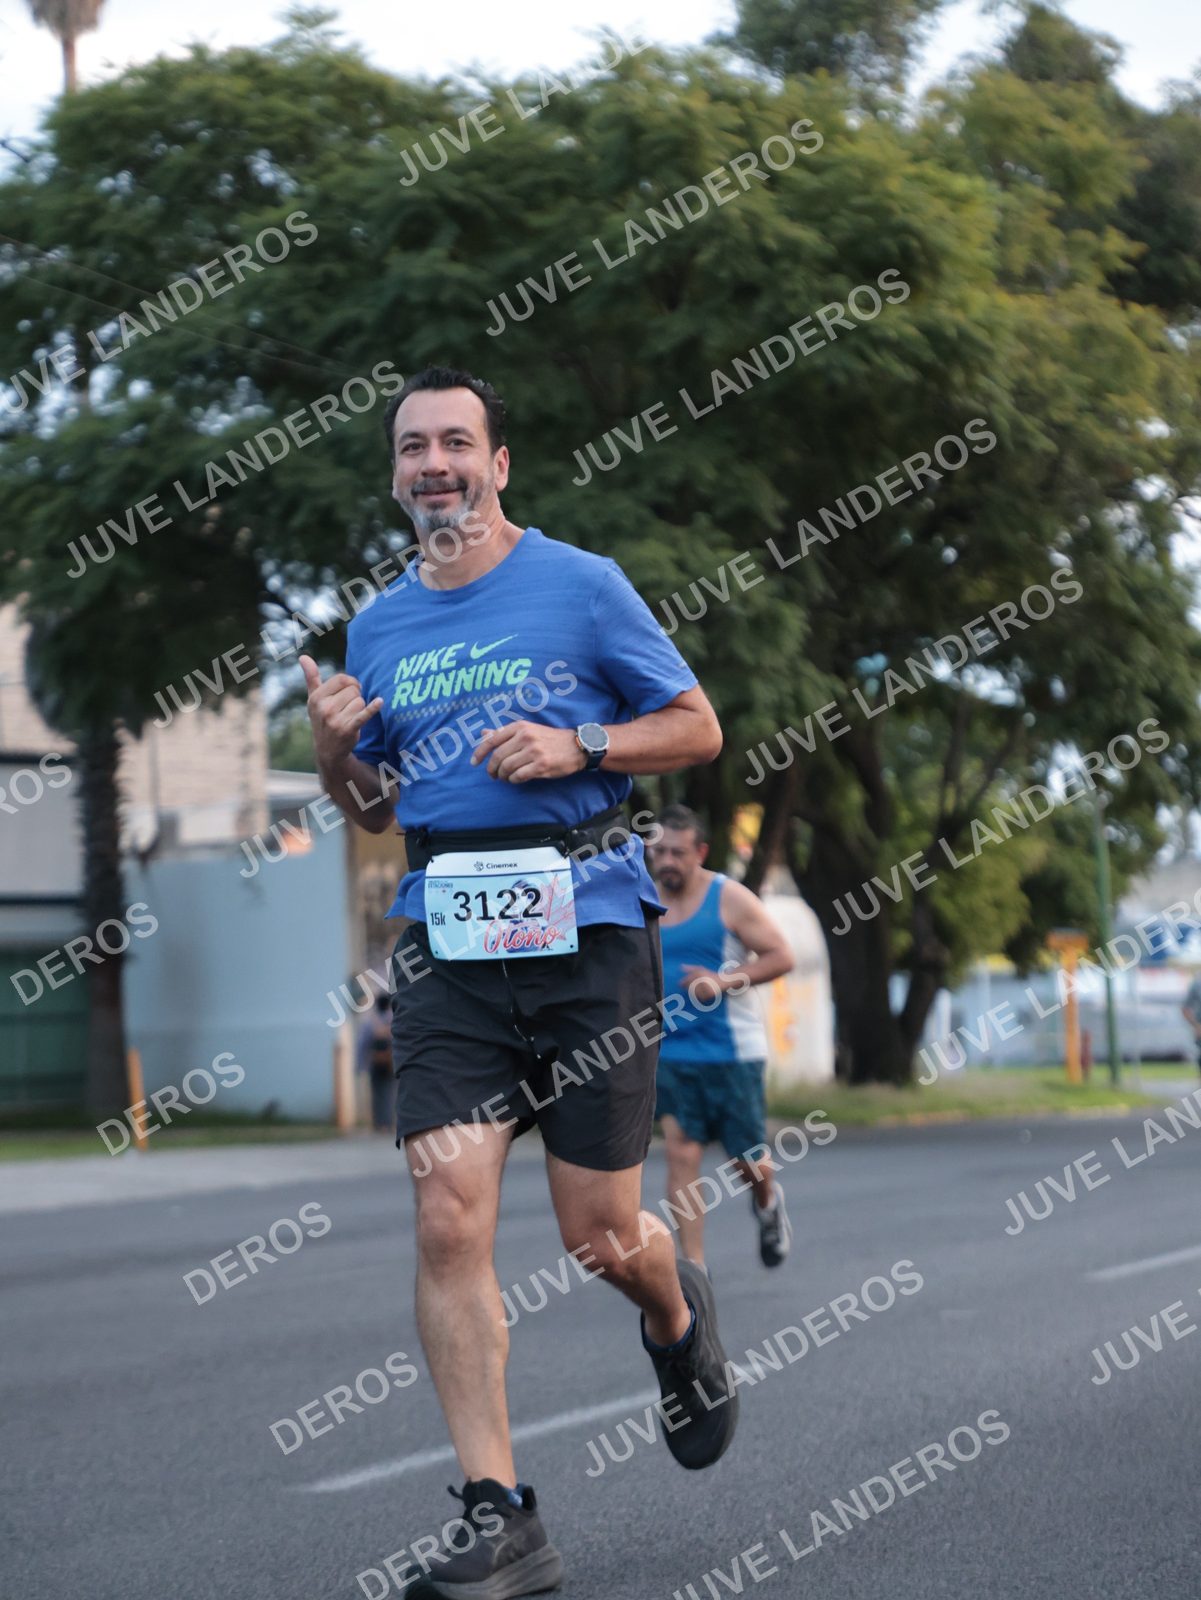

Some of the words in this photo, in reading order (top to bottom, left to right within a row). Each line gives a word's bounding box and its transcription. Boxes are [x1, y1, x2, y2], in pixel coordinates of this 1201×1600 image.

[391, 658, 532, 709] RUNNING
[393, 642, 465, 684] NIKE
[452, 887, 543, 922] 3122
